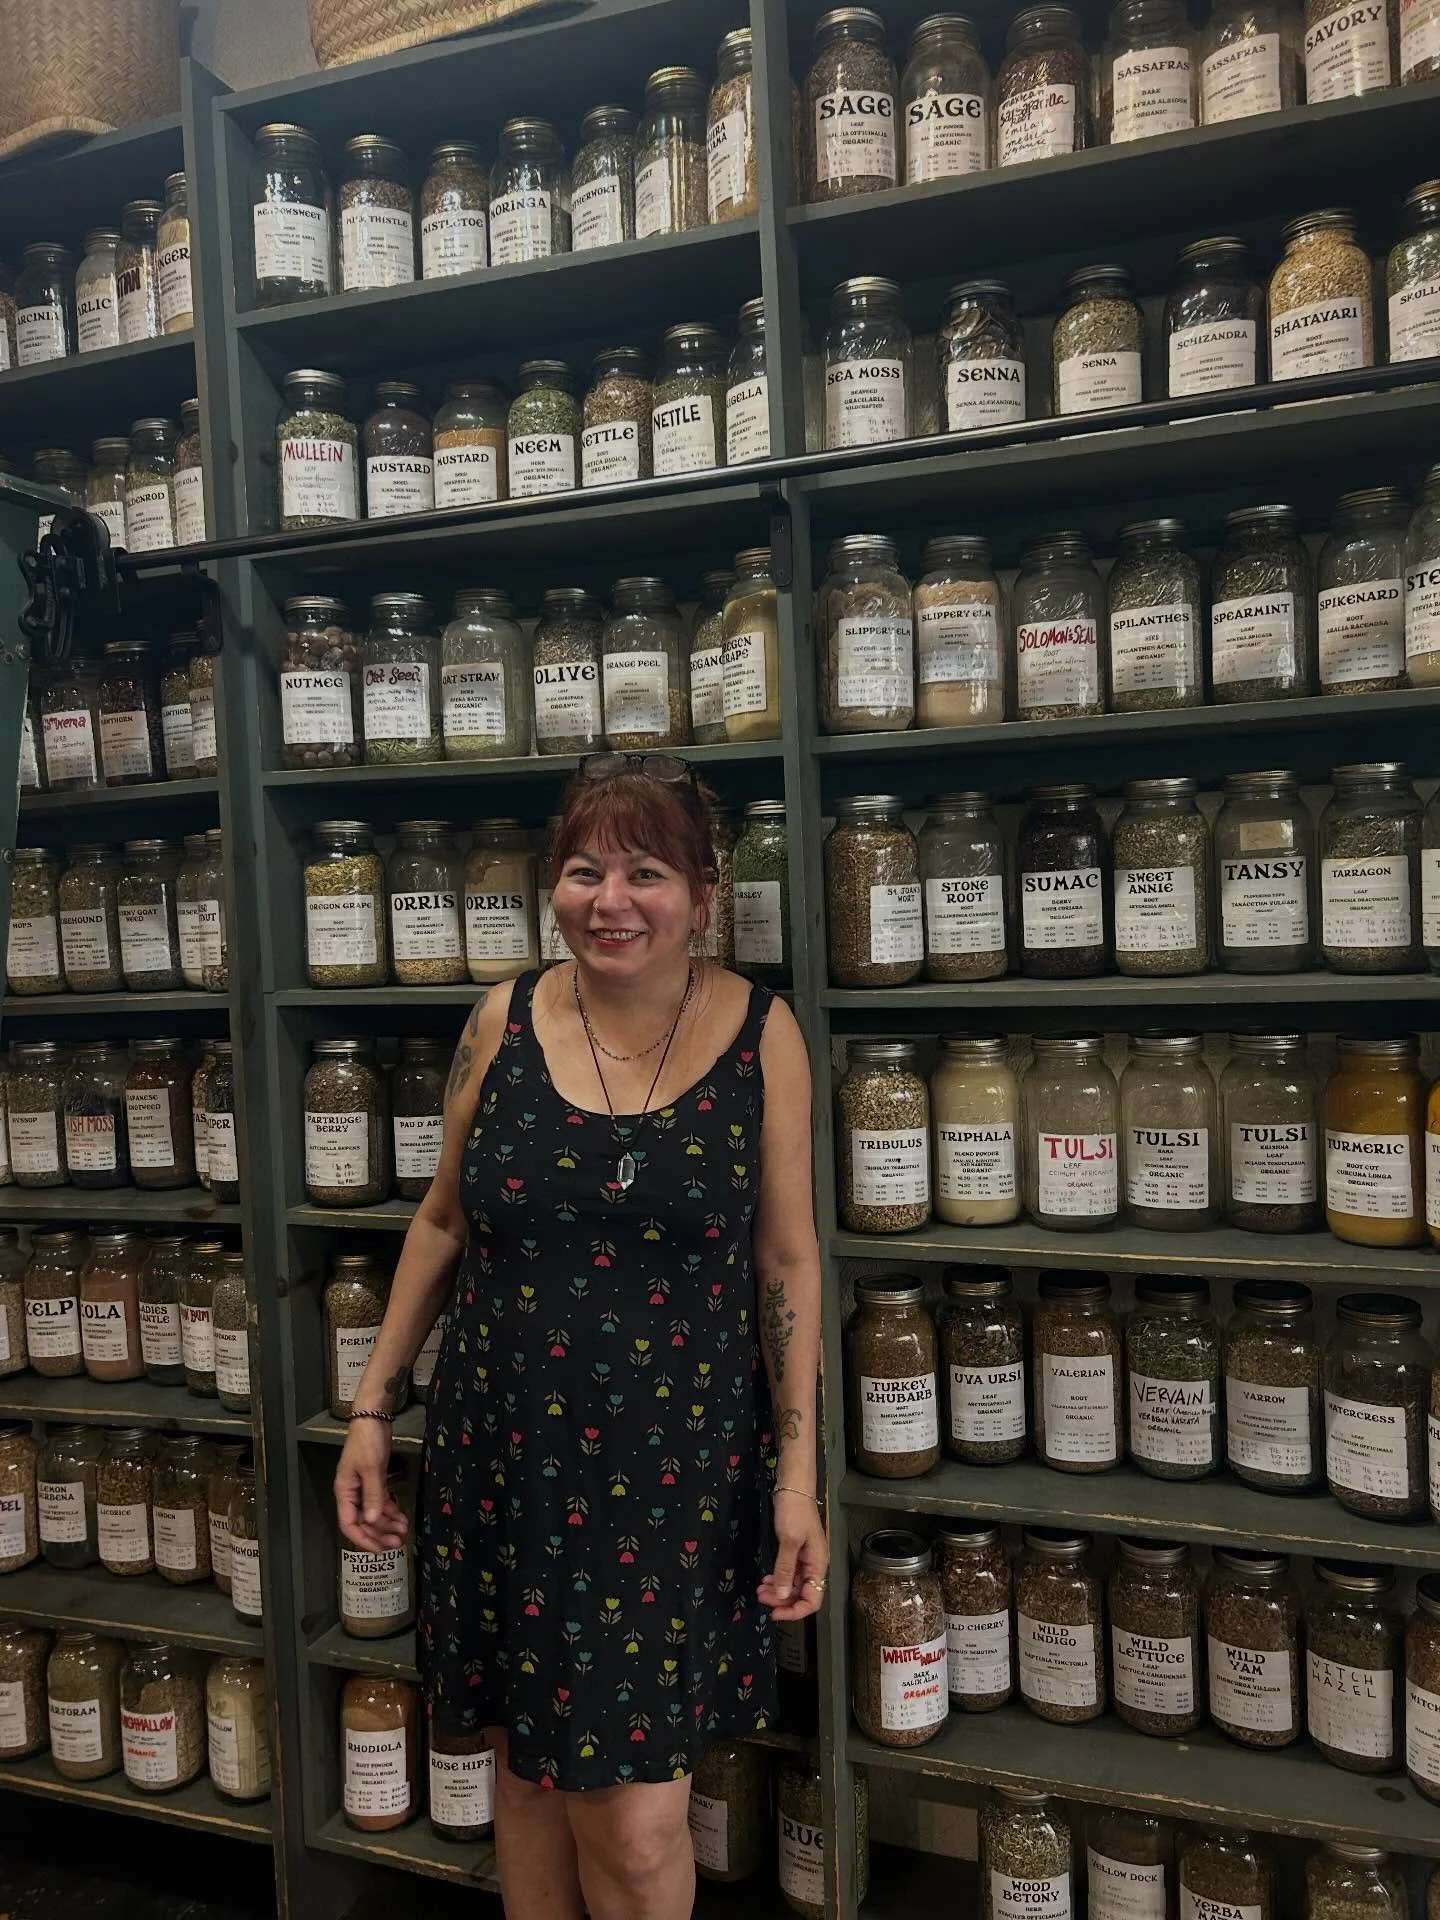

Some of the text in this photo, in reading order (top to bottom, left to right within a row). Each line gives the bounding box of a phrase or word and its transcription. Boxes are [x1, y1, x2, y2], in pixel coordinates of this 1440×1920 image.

[1306, 6, 1382, 54] SAVORY
[1206, 44, 1266, 76] SASSAFRAS
[1117, 59, 1191, 80] SASSAFRAS
[1141, 87, 1161, 95] BARK
[819, 98, 891, 121] SAGE
[908, 99, 981, 125] SAGE
[1135, 108, 1167, 118] ORGANIC
[368, 216, 408, 227] THISTLE
[1400, 281, 1440, 305] SKULL
[1273, 307, 1358, 338] SHATAVARI
[1177, 330, 1248, 350] SCHIZANDRA
[1082, 357, 1117, 369] SENNA
[827, 367, 900, 386] SEA MOSS
[957, 367, 1021, 383] SENNA
[653, 404, 701, 433] NETTLE
[515, 438, 562, 455] NEEM
[437, 454, 489, 466] MUSTARD
[371, 463, 431, 474] MUSTARD
[1319, 588, 1399, 611] SPIKENARD
[921, 610, 991, 622] SLIPPERY ELM
[1213, 603, 1291, 625] SPEARMINT
[1347, 614, 1364, 622] ROOT
[1113, 612, 1190, 631] SPILANTHES
[1351, 620, 1389, 631] RACEMOSA
[1072, 624, 1096, 645] SEAL
[1343, 631, 1369, 639] ORGANIC
[1136, 652, 1166, 660] ORGANIC
[638, 659, 661, 668] PEEL
[535, 665, 595, 685] OLIVE
[285, 677, 344, 689] NUTMEG
[1225, 861, 1304, 880] TANSY
[1331, 867, 1391, 878] TARRAGON
[1025, 873, 1099, 892] SUMAC
[1127, 872, 1174, 883] SWEET
[941, 880, 989, 892] STONE
[1129, 883, 1174, 894] ANNIE
[394, 894, 454, 911] ORRIS
[466, 895, 523, 911] ORRIS
[946, 892, 985, 903] ROOT
[137, 908, 157, 916] GOAT
[310, 902, 341, 910] OREGON
[87, 1115, 114, 1134] MOSS
[307, 1116, 362, 1124] PARTRIDGE
[400, 1120, 415, 1128] PAU
[316, 1124, 349, 1133] BERRY
[1240, 1127, 1308, 1143] TULSI
[940, 1130, 1011, 1142] TRIPHALA
[1133, 1129, 1199, 1147] TULSI
[859, 1138, 922, 1150] TRIBULUS
[1043, 1137, 1113, 1161] TULSI
[1327, 1137, 1405, 1155] TURMERIC
[1346, 1162, 1364, 1170] ROOT
[1149, 1170, 1184, 1178] ORGANIC
[1336, 1169, 1366, 1178] CURCUMA
[1347, 1179, 1378, 1187] ORGANIC
[340, 1336, 376, 1346] PERIWI
[954, 1370, 1021, 1385] UVA URSI
[1051, 1368, 1106, 1378] VALERIAN
[871, 1379, 928, 1392] TURKEY
[866, 1390, 932, 1403] RHUBARB
[1133, 1381, 1204, 1405] VERVAIN
[1243, 1390, 1286, 1404] YARROW
[1151, 1406, 1172, 1415] LEAF
[1328, 1402, 1396, 1424] WATERCRESS
[343, 1549, 405, 1564] PSYLLIUM
[352, 1562, 395, 1573] HUSKS
[967, 1620, 1004, 1631] CHERRY
[1037, 1623, 1070, 1636] WILD
[1032, 1631, 1077, 1647] INDIGO
[1131, 1637, 1169, 1652] WILD
[883, 1647, 920, 1665] WHITE
[1118, 1643, 1185, 1663] LETTUCE
[1226, 1647, 1266, 1664] WILD
[1230, 1660, 1263, 1676] YAM
[1311, 1659, 1374, 1686] WITCH
[1137, 1678, 1166, 1687] ORGANIC
[1312, 1673, 1376, 1699] HAZEL
[903, 1685, 940, 1700] ORGANIC
[1233, 1688, 1262, 1698] ORGANIC
[348, 1741, 402, 1753] RHODIOLA
[432, 1757, 492, 1771] ROSE HIPS
[1129, 1873, 1159, 1883] DOCK
[1011, 1880, 1051, 1893] WOOD
[1003, 1890, 1060, 1903] BETONY
[1192, 1895, 1243, 1919] YERBA
